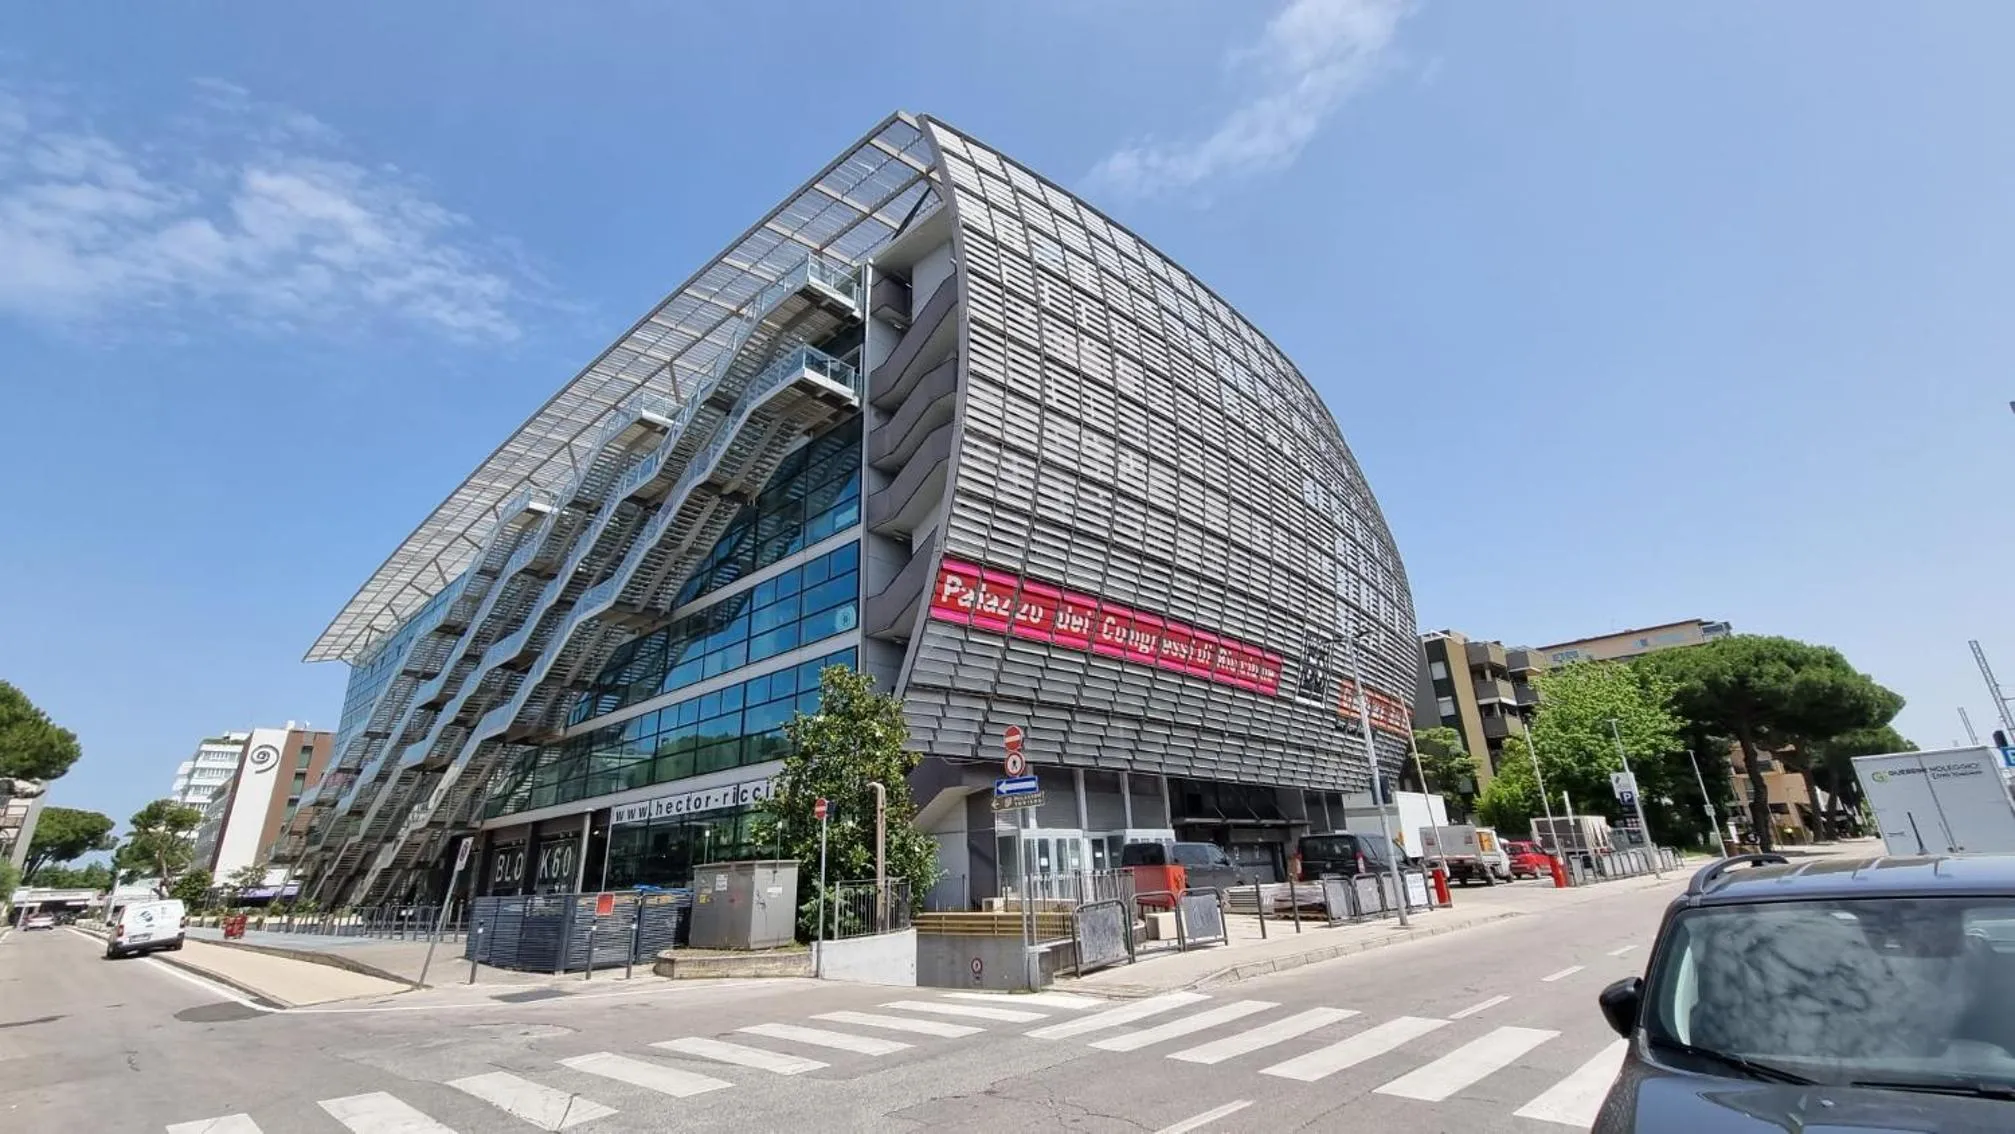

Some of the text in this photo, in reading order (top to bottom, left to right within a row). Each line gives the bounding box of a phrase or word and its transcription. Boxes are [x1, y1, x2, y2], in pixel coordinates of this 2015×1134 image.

[941, 574, 1044, 624] Palazzo
[1055, 605, 1092, 634] dei
[1102, 615, 1196, 661] Congressi
[1196, 643, 1213, 665] di
[616, 781, 771, 822] www.hector-ricci
